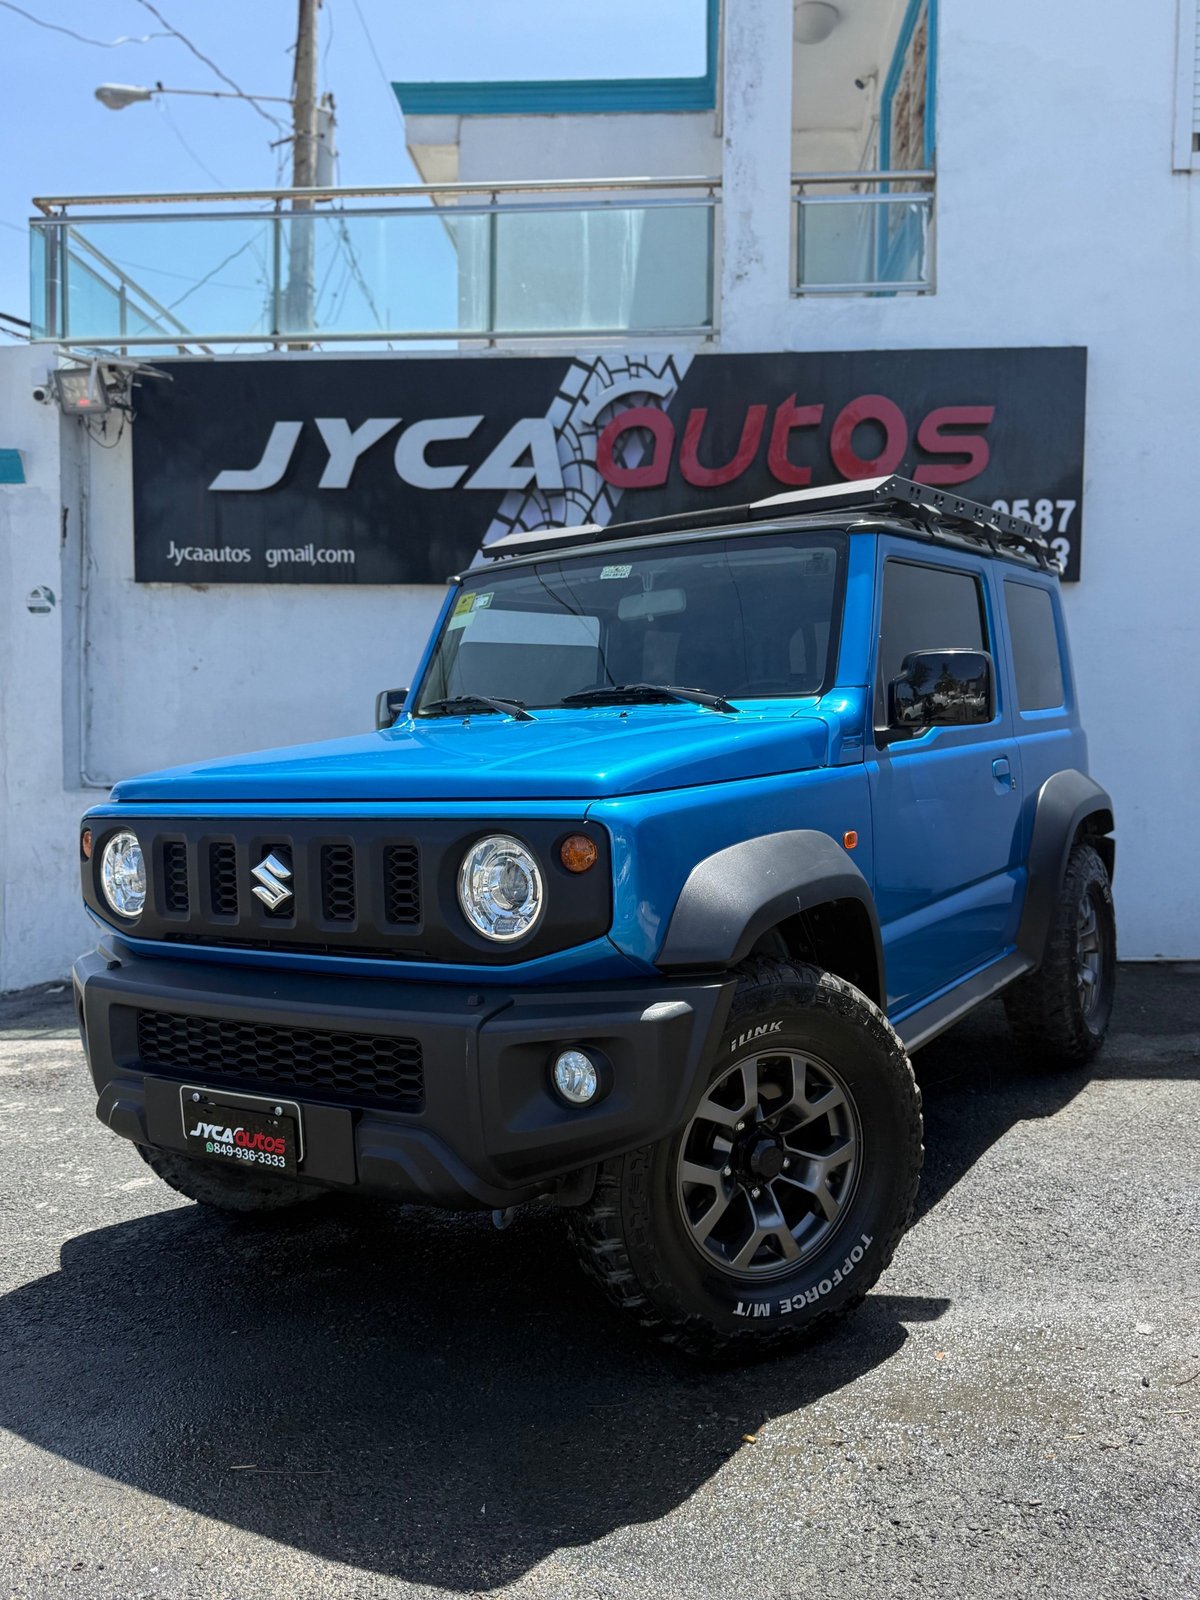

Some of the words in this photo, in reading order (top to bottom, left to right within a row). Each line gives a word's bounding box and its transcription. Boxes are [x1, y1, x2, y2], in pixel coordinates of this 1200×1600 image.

[208, 415, 564, 491] JYCA
[595, 393, 996, 488] autos
[166, 540, 251, 566] Jycaautos
[213, 1142, 286, 1168] 849-936-3333
[779, 1233, 874, 1314] TOPFORCE
[732, 1301, 770, 1317] M/T
